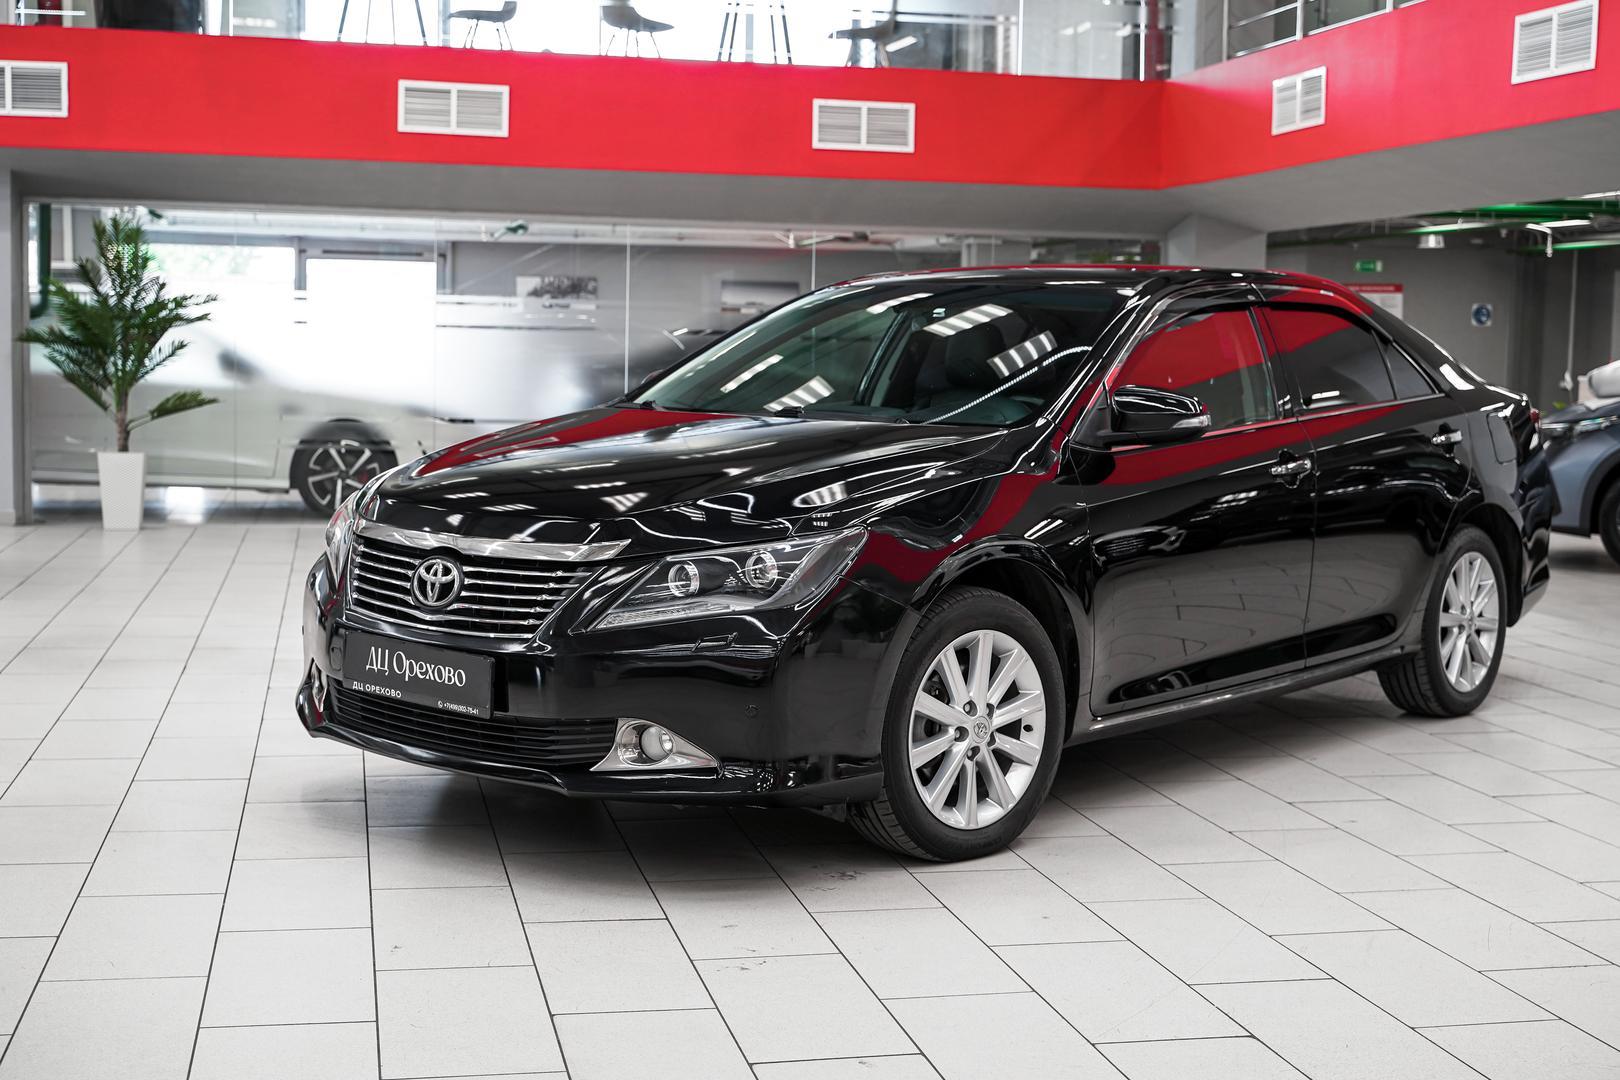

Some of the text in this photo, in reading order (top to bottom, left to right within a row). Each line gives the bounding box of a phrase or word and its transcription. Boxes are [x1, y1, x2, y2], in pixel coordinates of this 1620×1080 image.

[365, 646, 466, 687] ДЦ Орехово
[352, 681, 402, 698] ДЦ ОРЕХОВО
